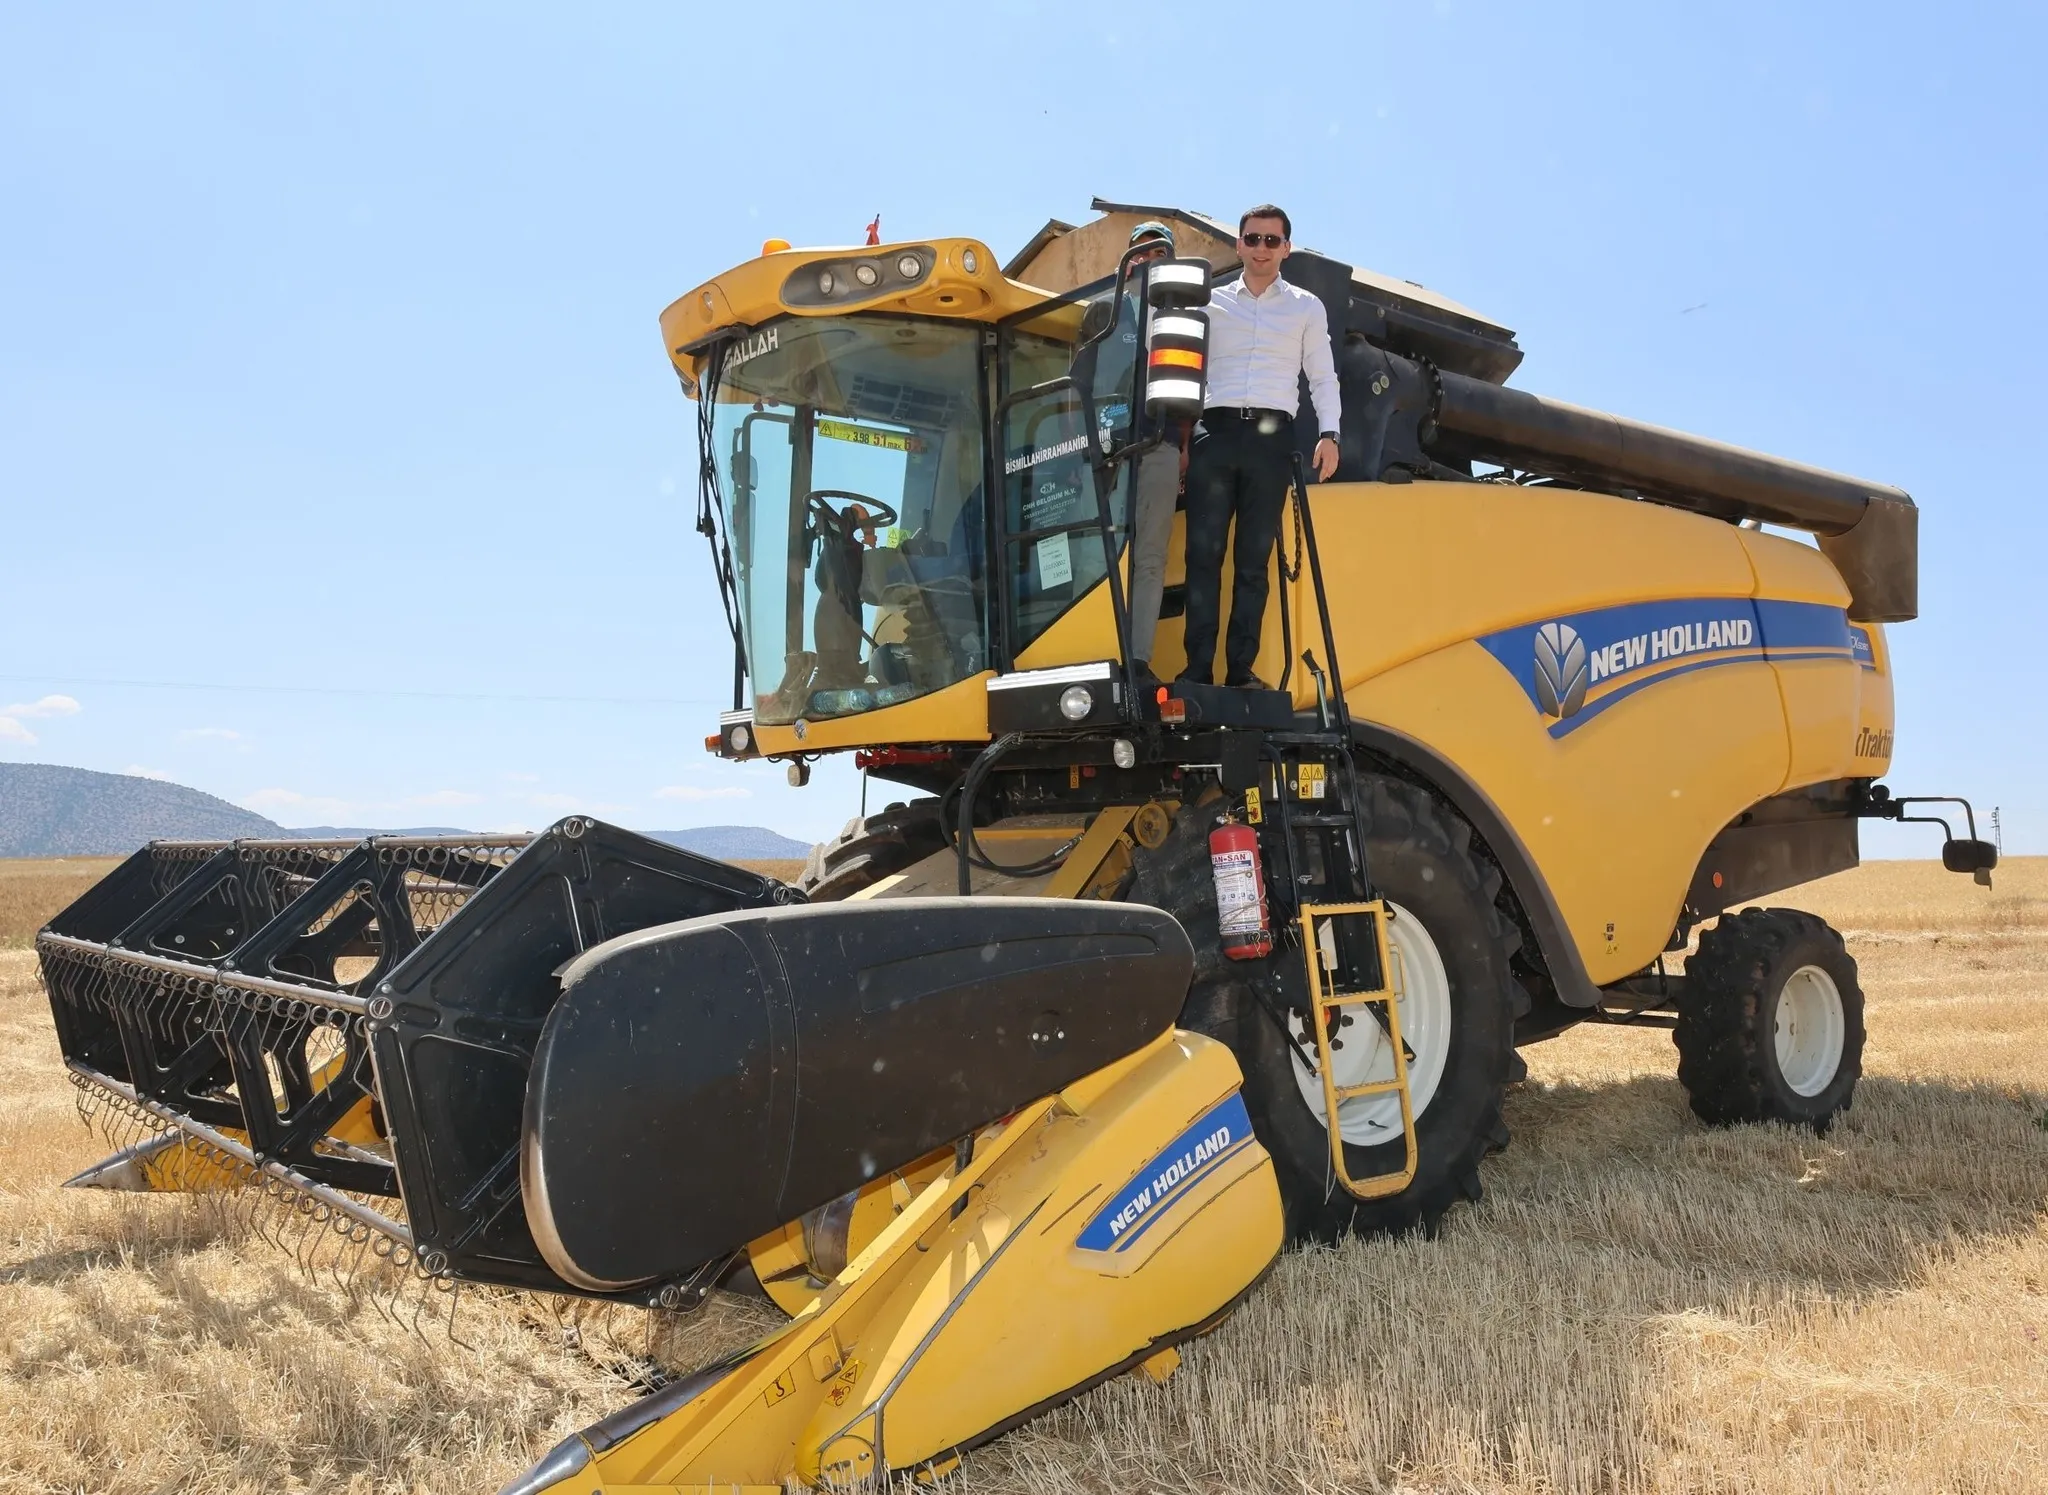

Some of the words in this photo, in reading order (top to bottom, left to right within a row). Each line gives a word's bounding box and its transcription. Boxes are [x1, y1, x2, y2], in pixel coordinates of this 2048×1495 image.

[1036, 491, 1063, 506] BELGIUM
[1591, 634, 1648, 682] NEW
[1651, 619, 1753, 661] HOLLAND
[1109, 1187, 1152, 1237] NEW
[1152, 1126, 1230, 1198] HOLLAND
